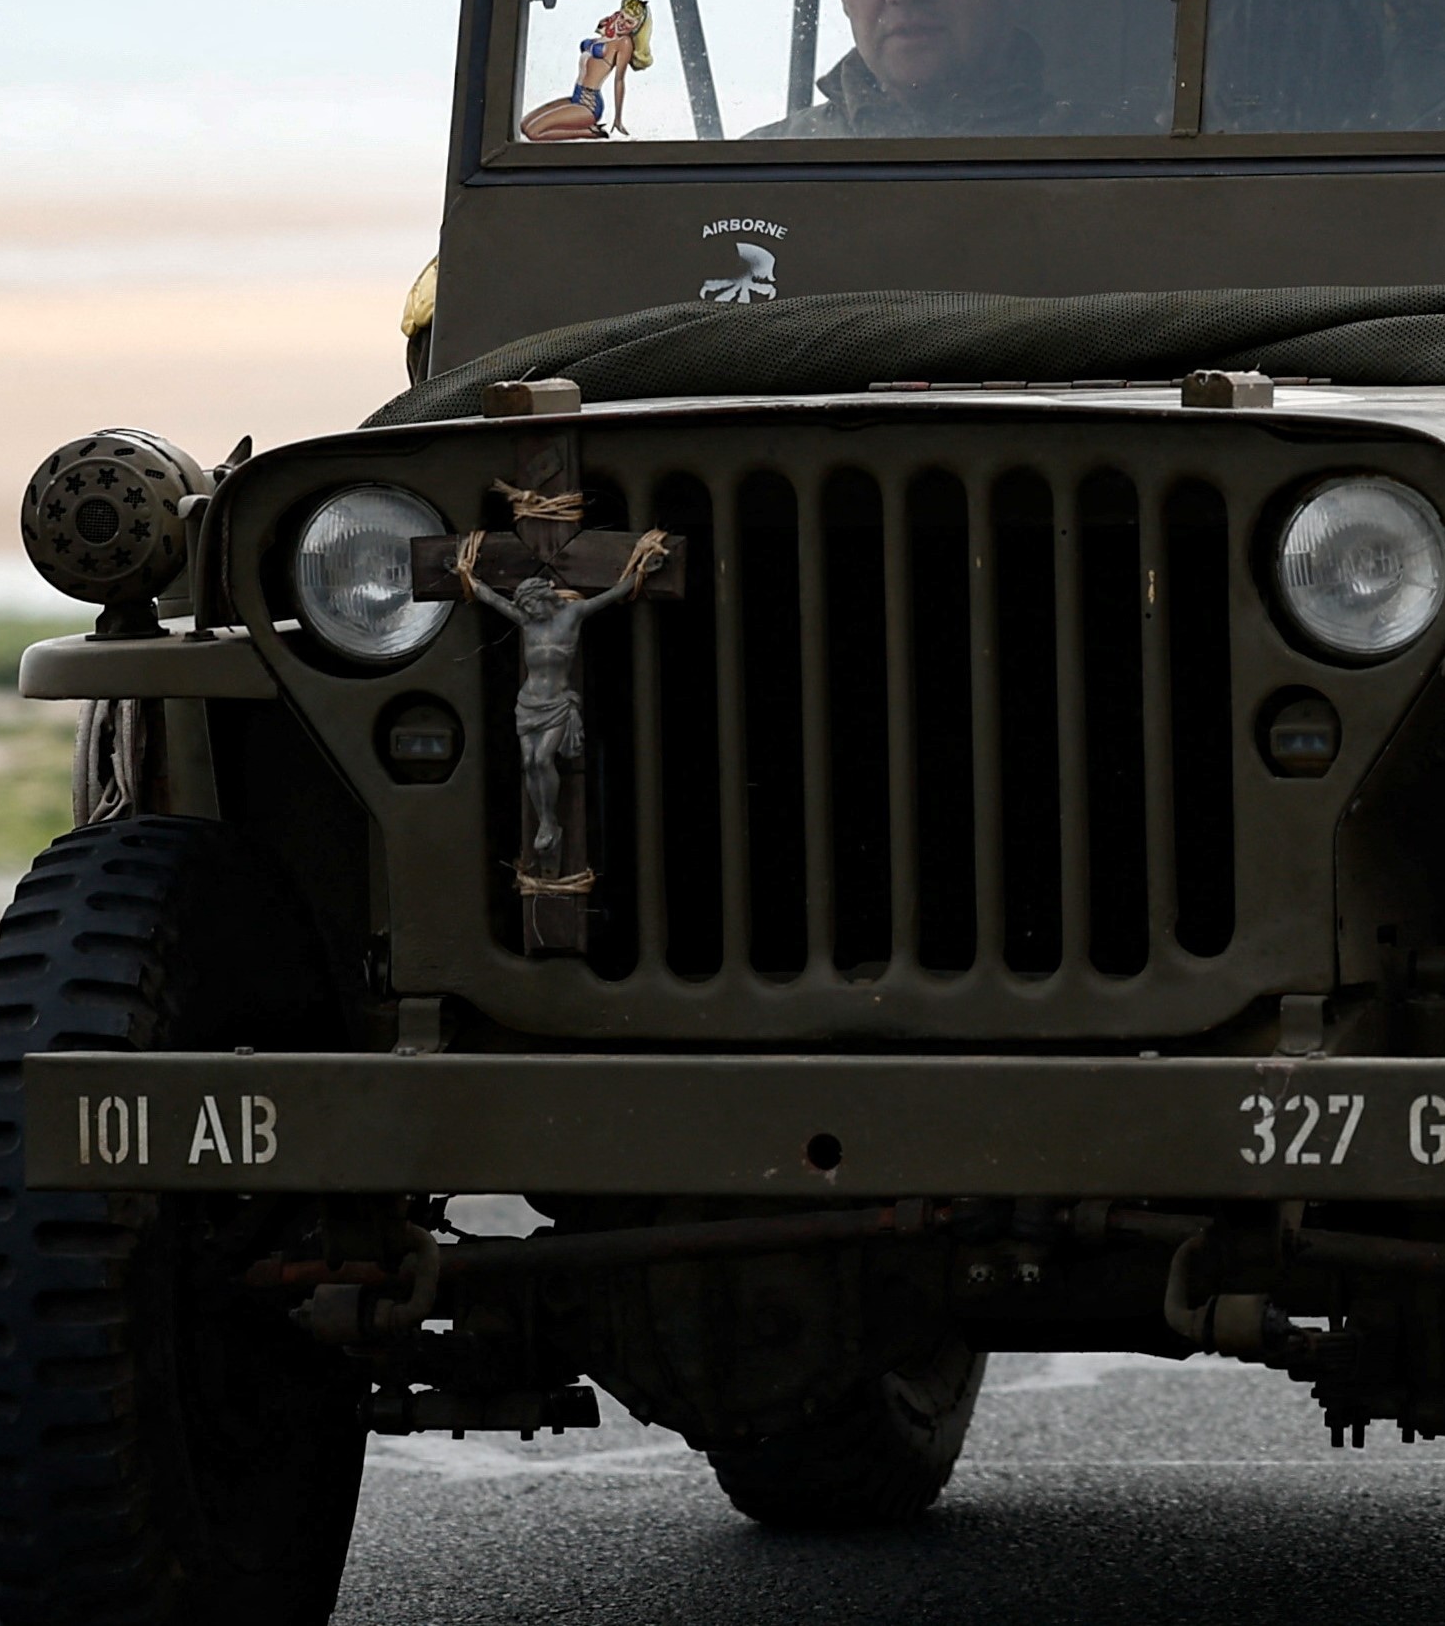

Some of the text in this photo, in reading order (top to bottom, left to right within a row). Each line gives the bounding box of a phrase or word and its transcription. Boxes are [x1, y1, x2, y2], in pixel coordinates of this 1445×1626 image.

[702, 218, 789, 240] AIRBORNE
[78, 1095, 278, 1165] 101 AB
[1239, 1094, 1365, 1164] 327
